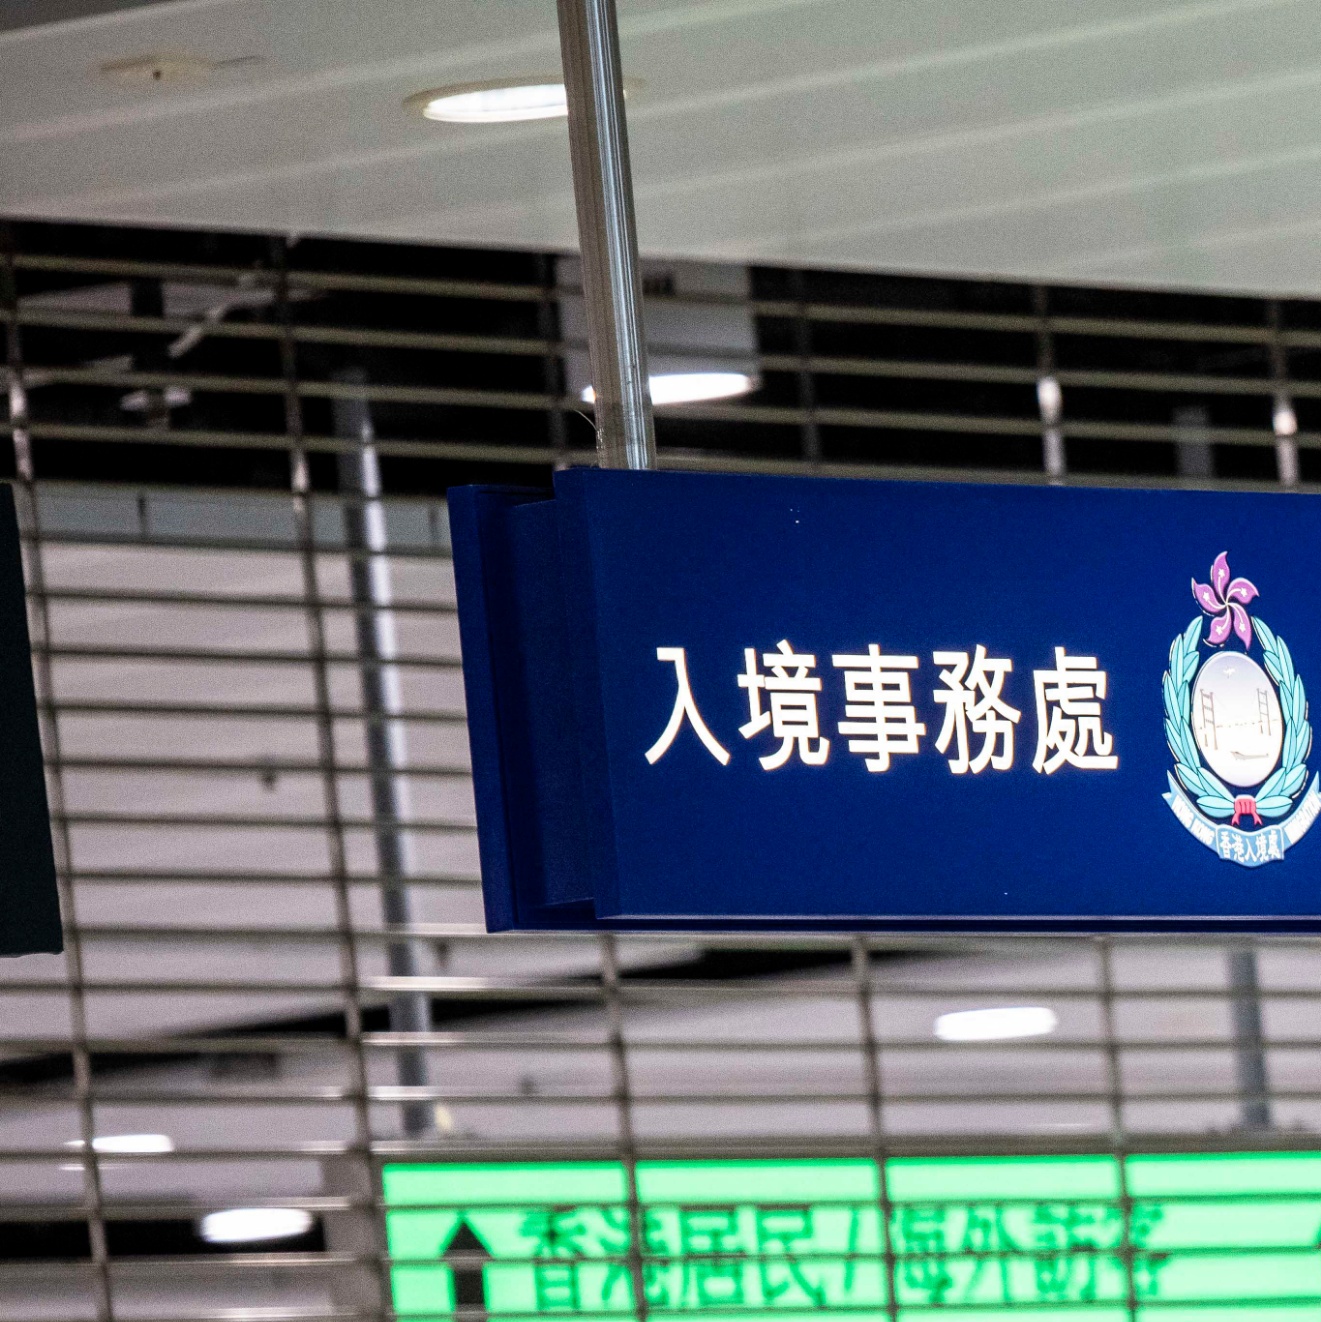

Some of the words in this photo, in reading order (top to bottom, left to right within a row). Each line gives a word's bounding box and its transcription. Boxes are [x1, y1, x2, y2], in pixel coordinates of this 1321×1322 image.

[645, 640, 1119, 775] 入境事務處
